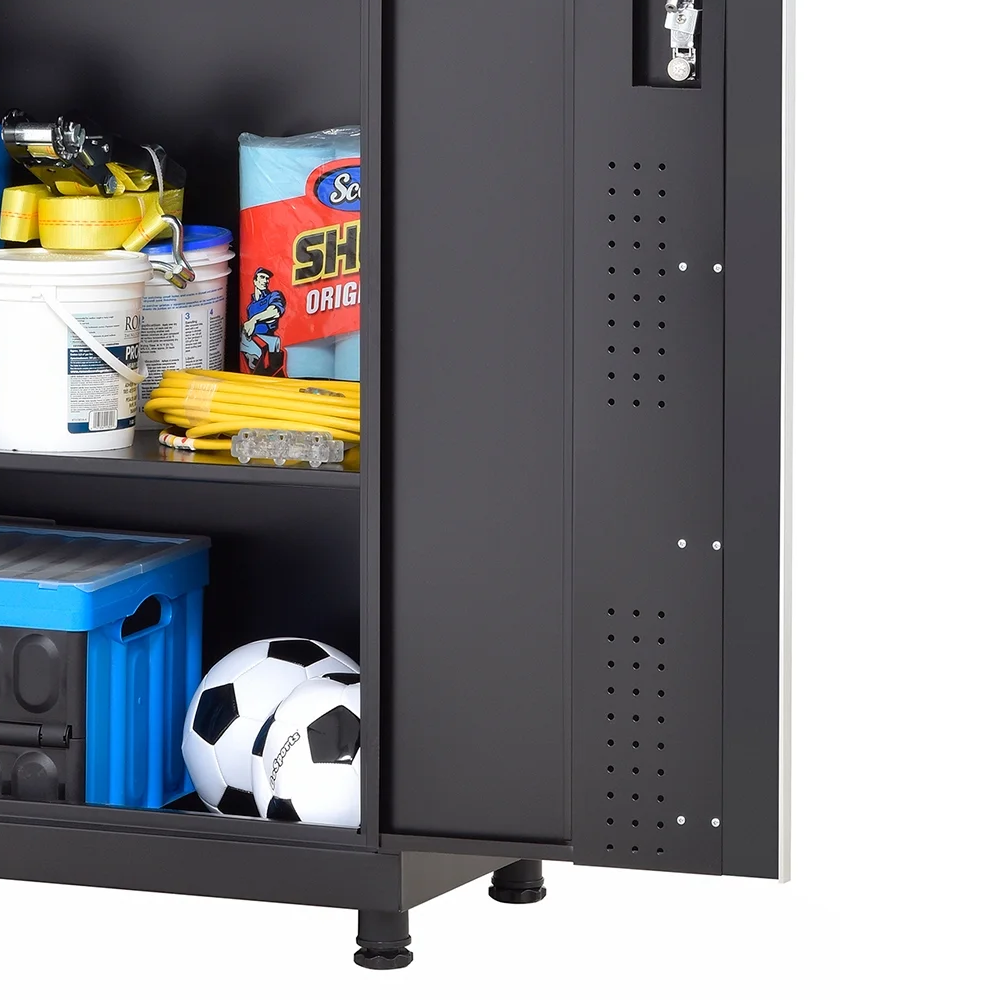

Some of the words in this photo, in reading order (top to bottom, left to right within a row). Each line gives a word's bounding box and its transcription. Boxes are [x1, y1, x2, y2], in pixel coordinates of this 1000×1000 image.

[330, 172, 361, 203] Sc
[292, 218, 361, 286] SH
[185, 312, 190, 320] 3
